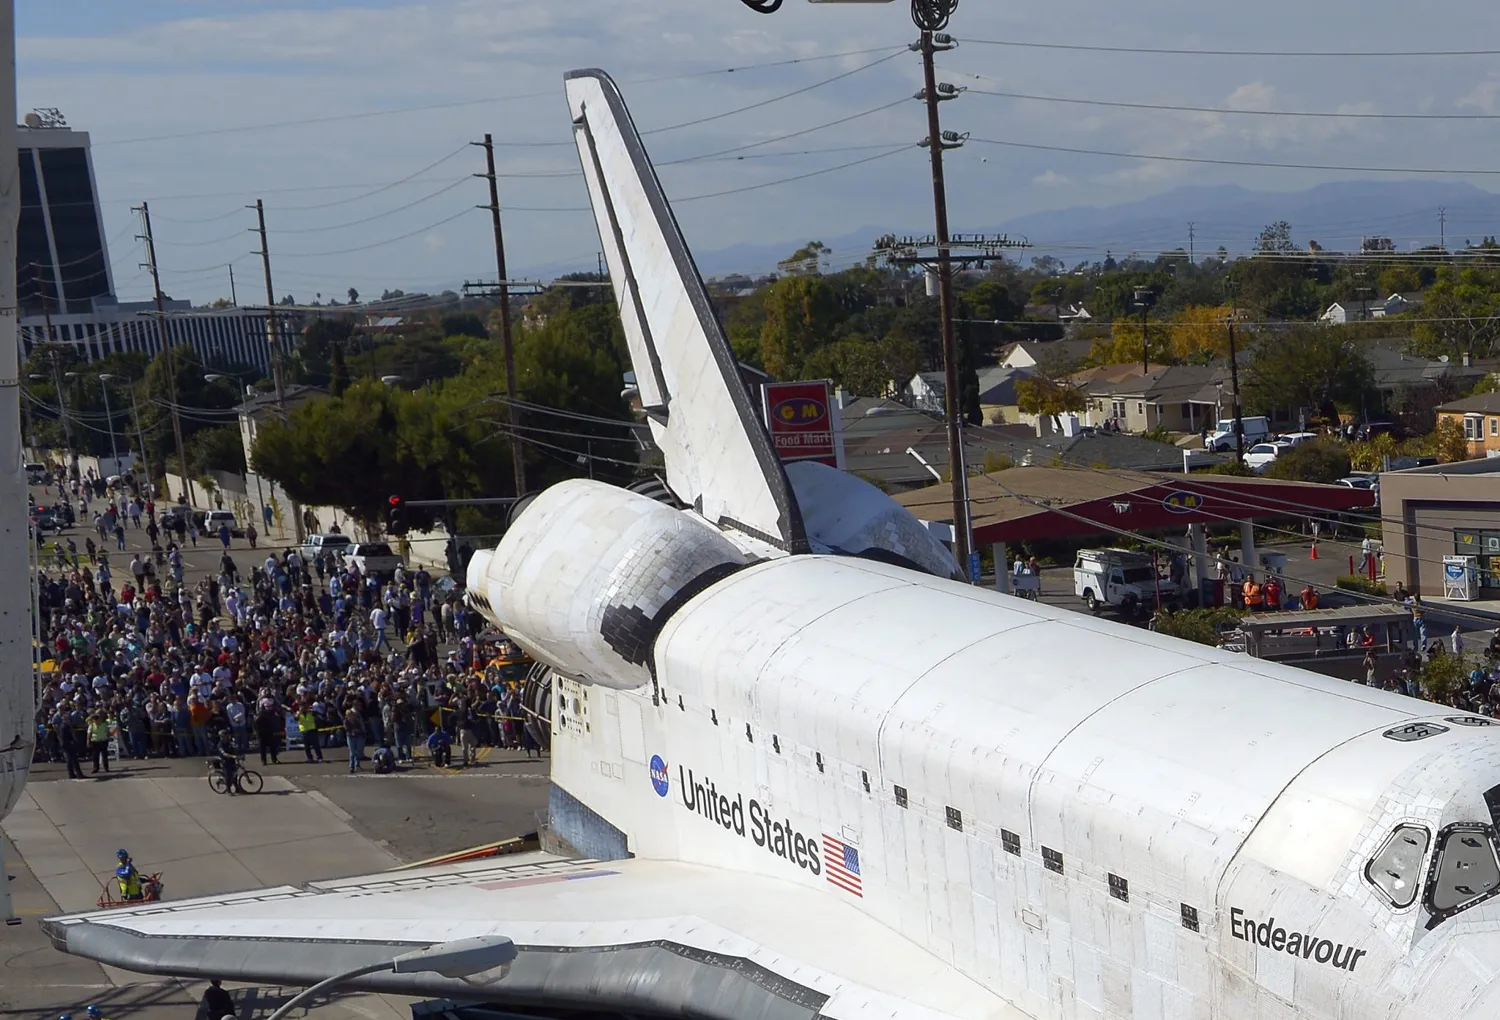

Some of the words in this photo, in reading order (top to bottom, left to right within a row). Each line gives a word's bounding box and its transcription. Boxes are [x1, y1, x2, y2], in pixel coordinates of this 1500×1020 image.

[775, 434, 800, 447] Food
[803, 433, 829, 445] Mart
[651, 769, 669, 783] NASA
[679, 764, 746, 837] United
[750, 799, 821, 876] States
[1230, 907, 1367, 972] Endeavour
